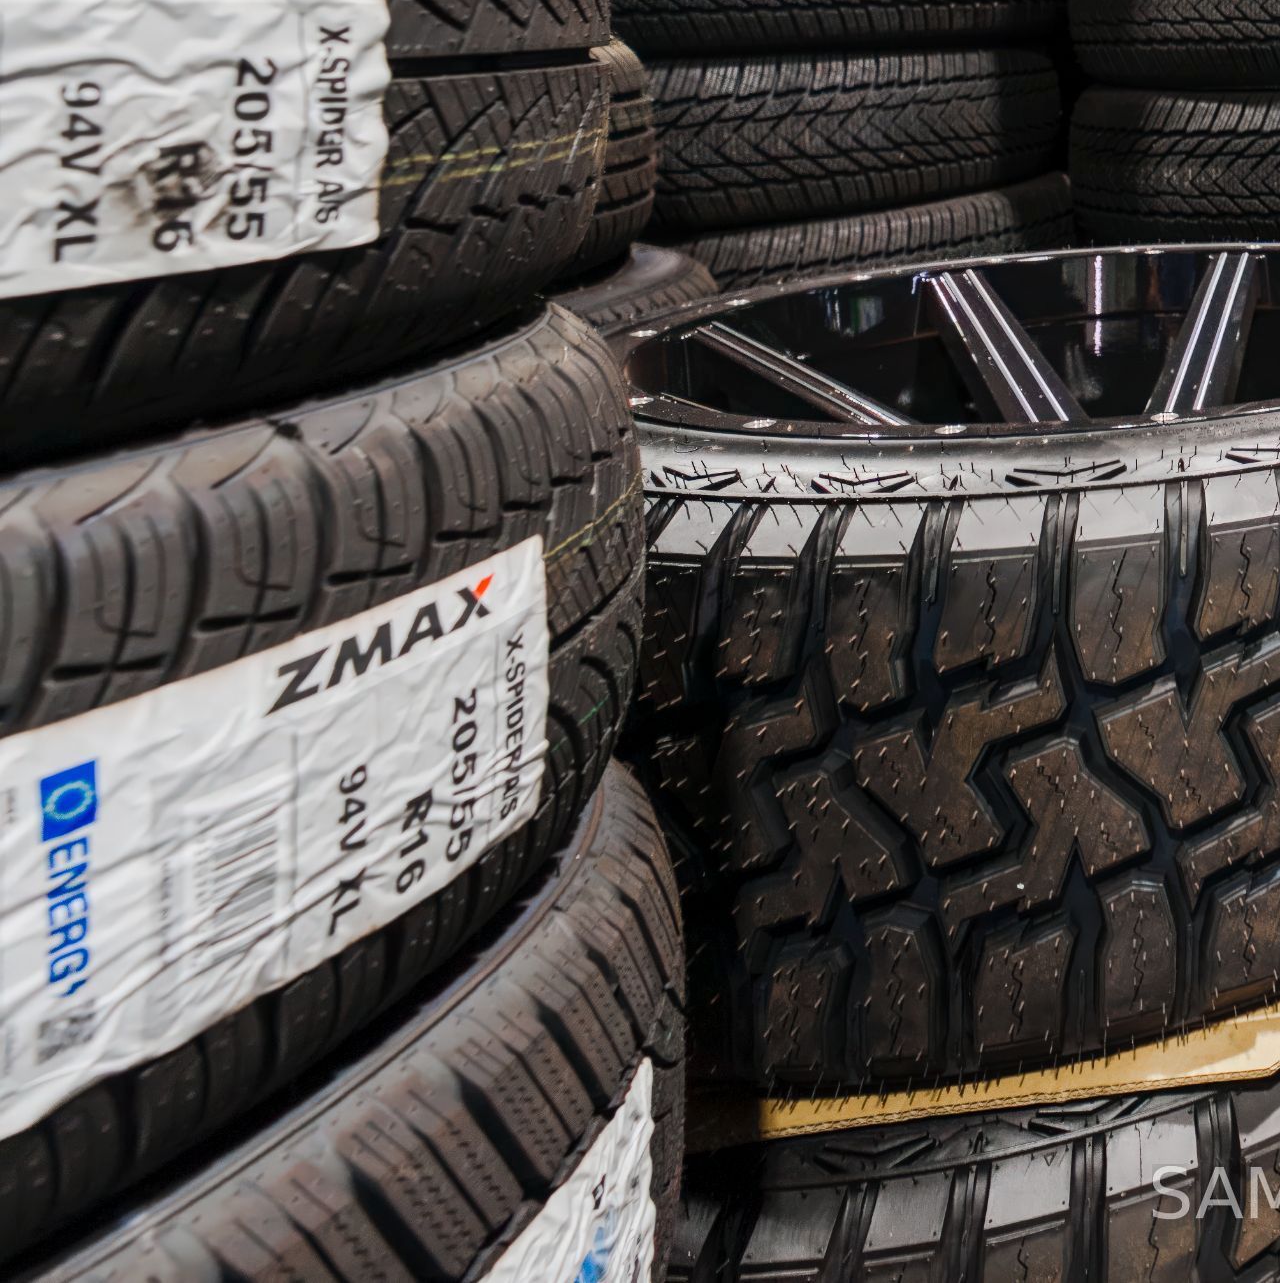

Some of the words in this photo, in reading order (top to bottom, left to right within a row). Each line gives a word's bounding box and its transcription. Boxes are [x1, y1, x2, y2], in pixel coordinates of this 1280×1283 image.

[59, 81, 103, 177] 94V
[225, 57, 276, 242] 205/55
[52, 200, 100, 262] XL
[152, 142, 203, 254] R16
[264, 573, 495, 716] ZMAX
[339, 764, 369, 852] 94V
[445, 687, 478, 863] 205/55
[395, 789, 433, 895] R16
[328, 867, 367, 937] XL
